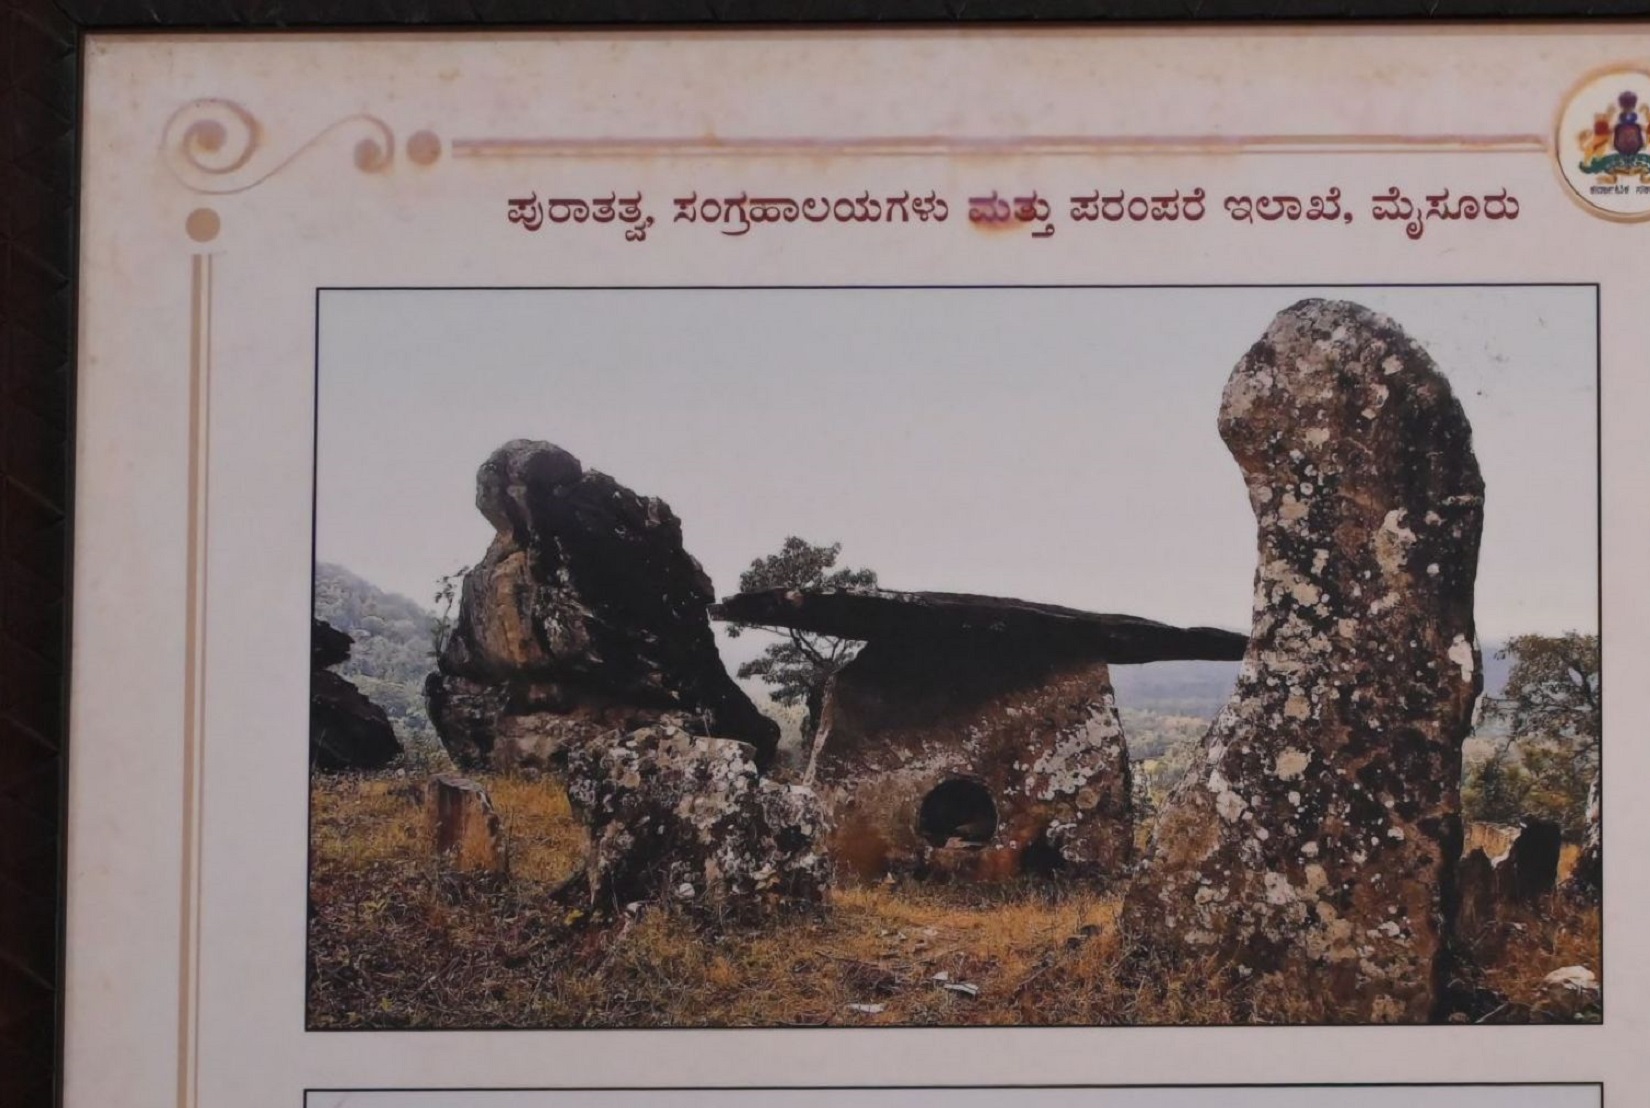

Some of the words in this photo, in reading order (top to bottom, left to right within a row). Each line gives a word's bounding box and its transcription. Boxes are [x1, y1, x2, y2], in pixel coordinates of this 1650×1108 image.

[507, 190, 656, 242] ಪುರಾತತ್ವ,
[673, 190, 949, 236] ಸಂಗ್ರಹಾಲಯಗಳು
[968, 190, 1056, 238] ಮತ್ತು
[1069, 187, 1206, 222] ಪರಂಪರೆ
[1223, 186, 1354, 225] ಇಲಾಖೆ,
[1371, 186, 1520, 240] ಮೈಸೂರು
